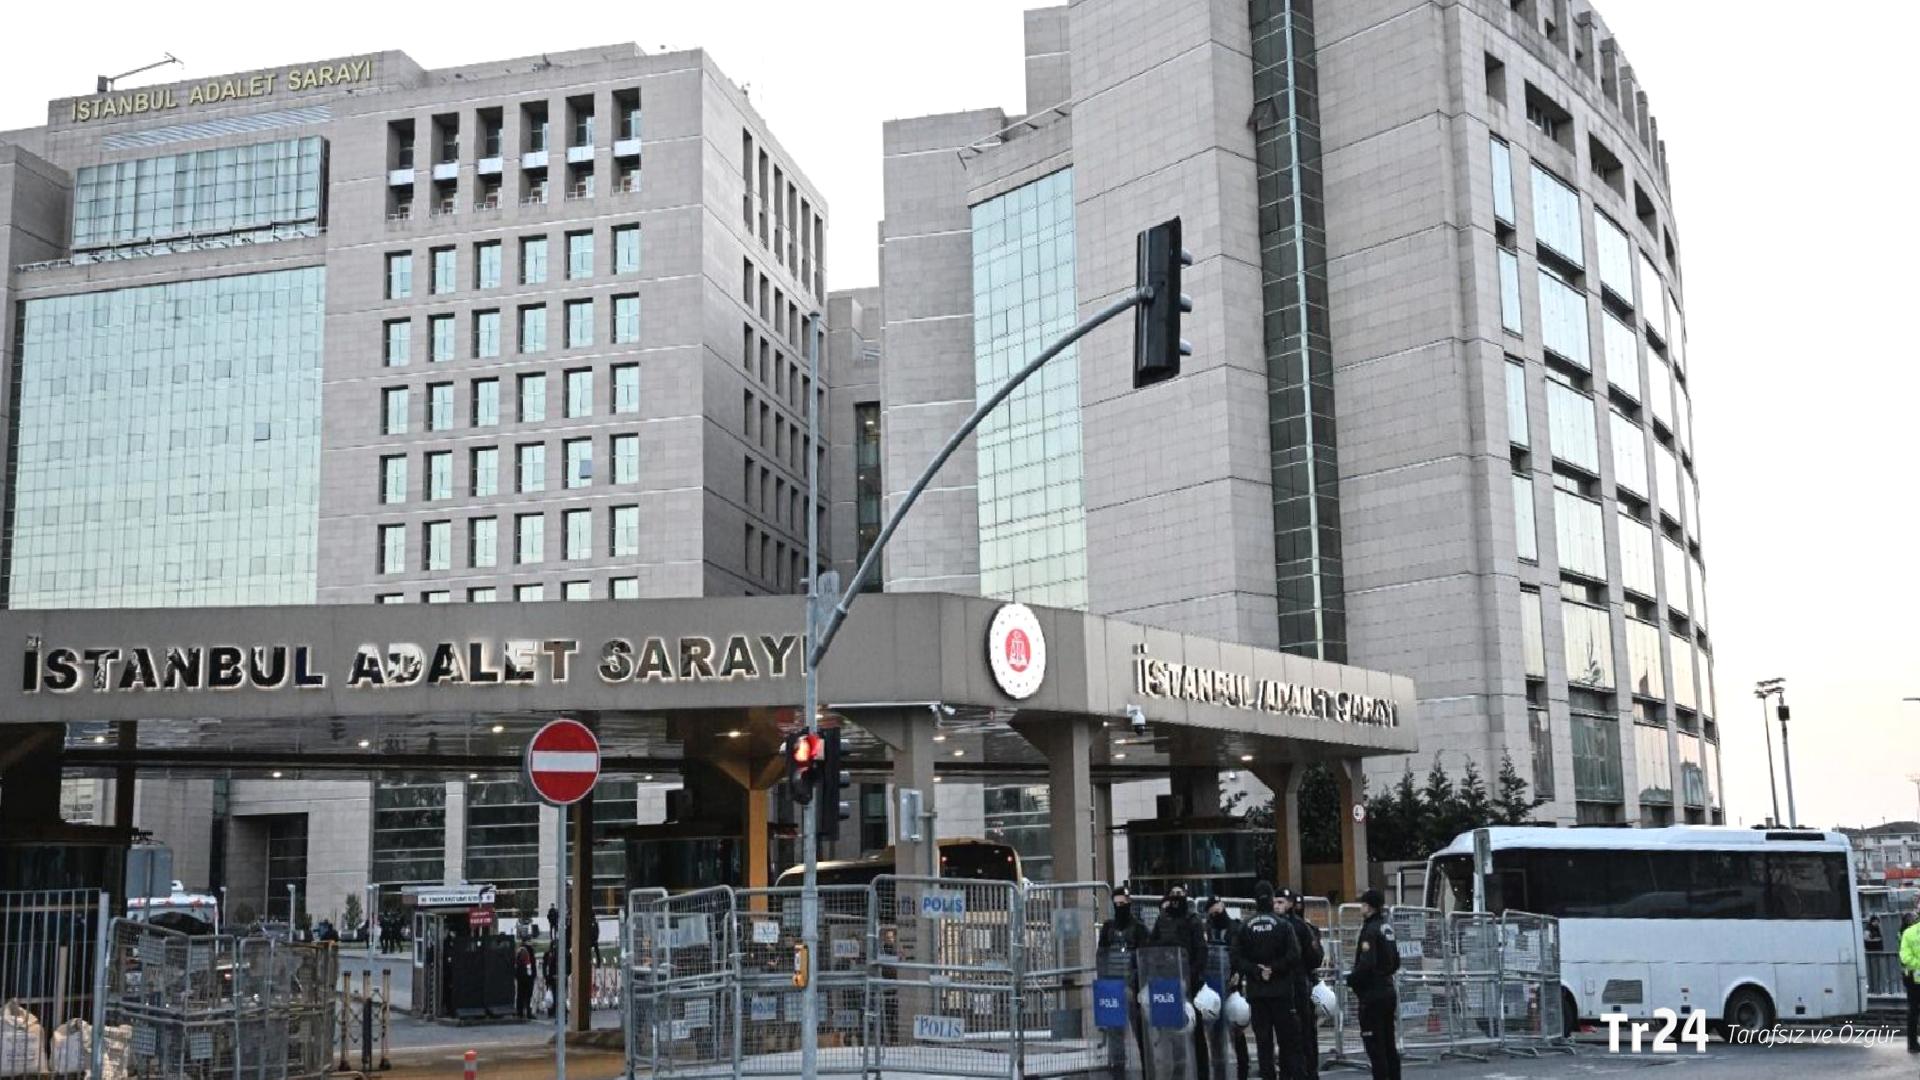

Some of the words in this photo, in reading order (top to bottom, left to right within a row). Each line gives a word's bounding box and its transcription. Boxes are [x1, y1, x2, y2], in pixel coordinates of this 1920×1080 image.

[72, 89, 177, 123] İSTANBUL
[189, 73, 278, 105] ADALET
[288, 60, 372, 91] SARAYI
[22, 634, 326, 692] İSTANBUL
[346, 639, 578, 688] ADALET
[1136, 643, 1252, 709] İSTANBUL
